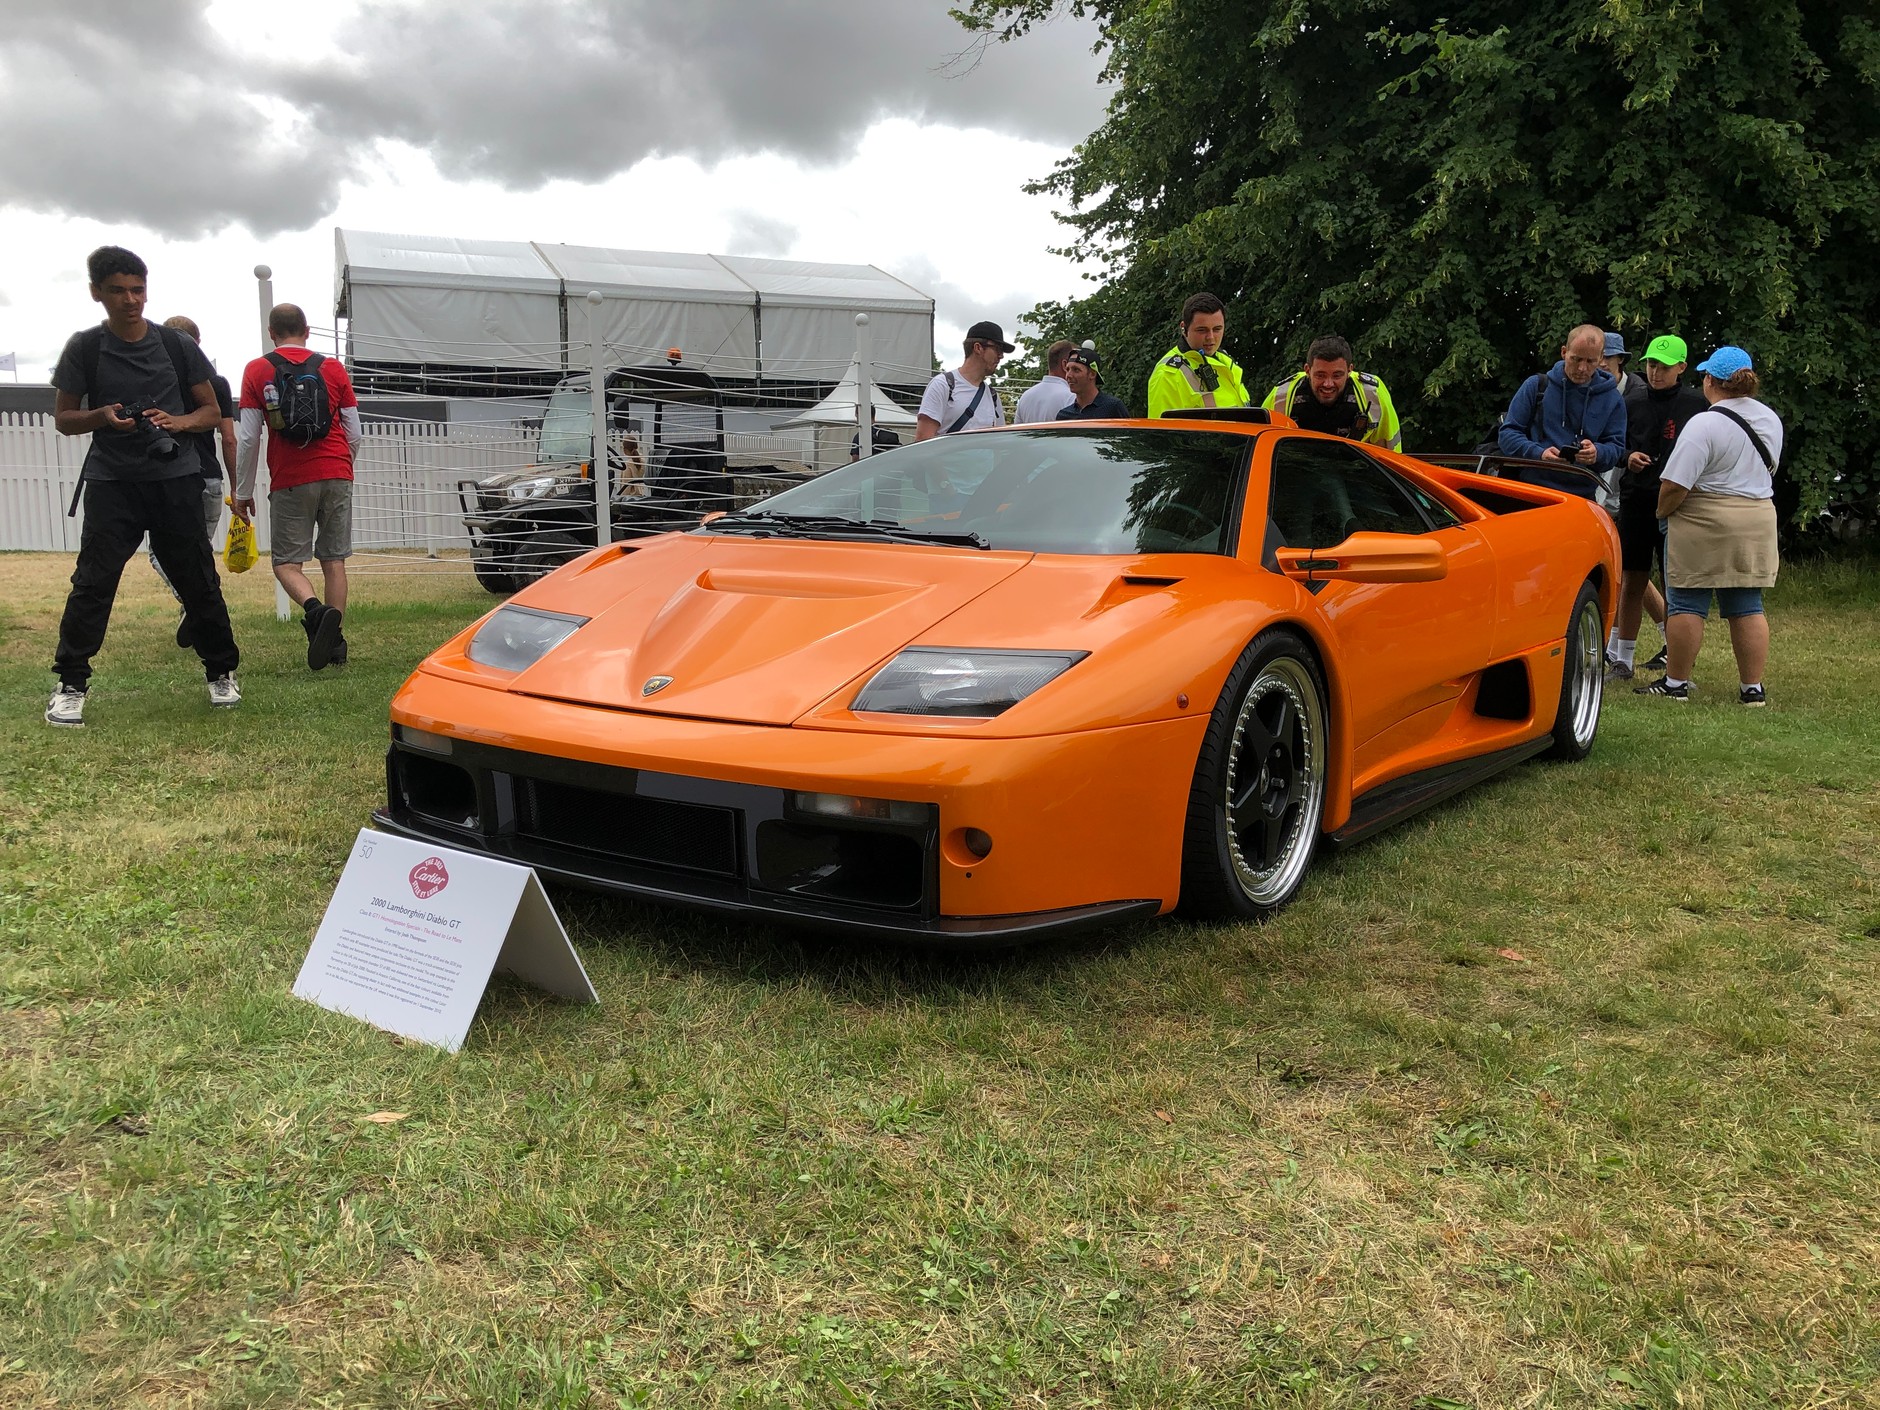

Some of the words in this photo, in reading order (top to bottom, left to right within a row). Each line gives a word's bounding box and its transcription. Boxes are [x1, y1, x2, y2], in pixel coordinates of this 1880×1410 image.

[359, 845, 373, 859] 50
[425, 858, 435, 866] THE
[413, 866, 446, 885] Cartier
[412, 880, 421, 896] STYLE
[427, 885, 439, 897] LUXE
[371, 896, 387, 908] 2000
[386, 901, 427, 919] Lamborghini
[426, 912, 448, 926] Diablo
[449, 919, 462, 929] GT
